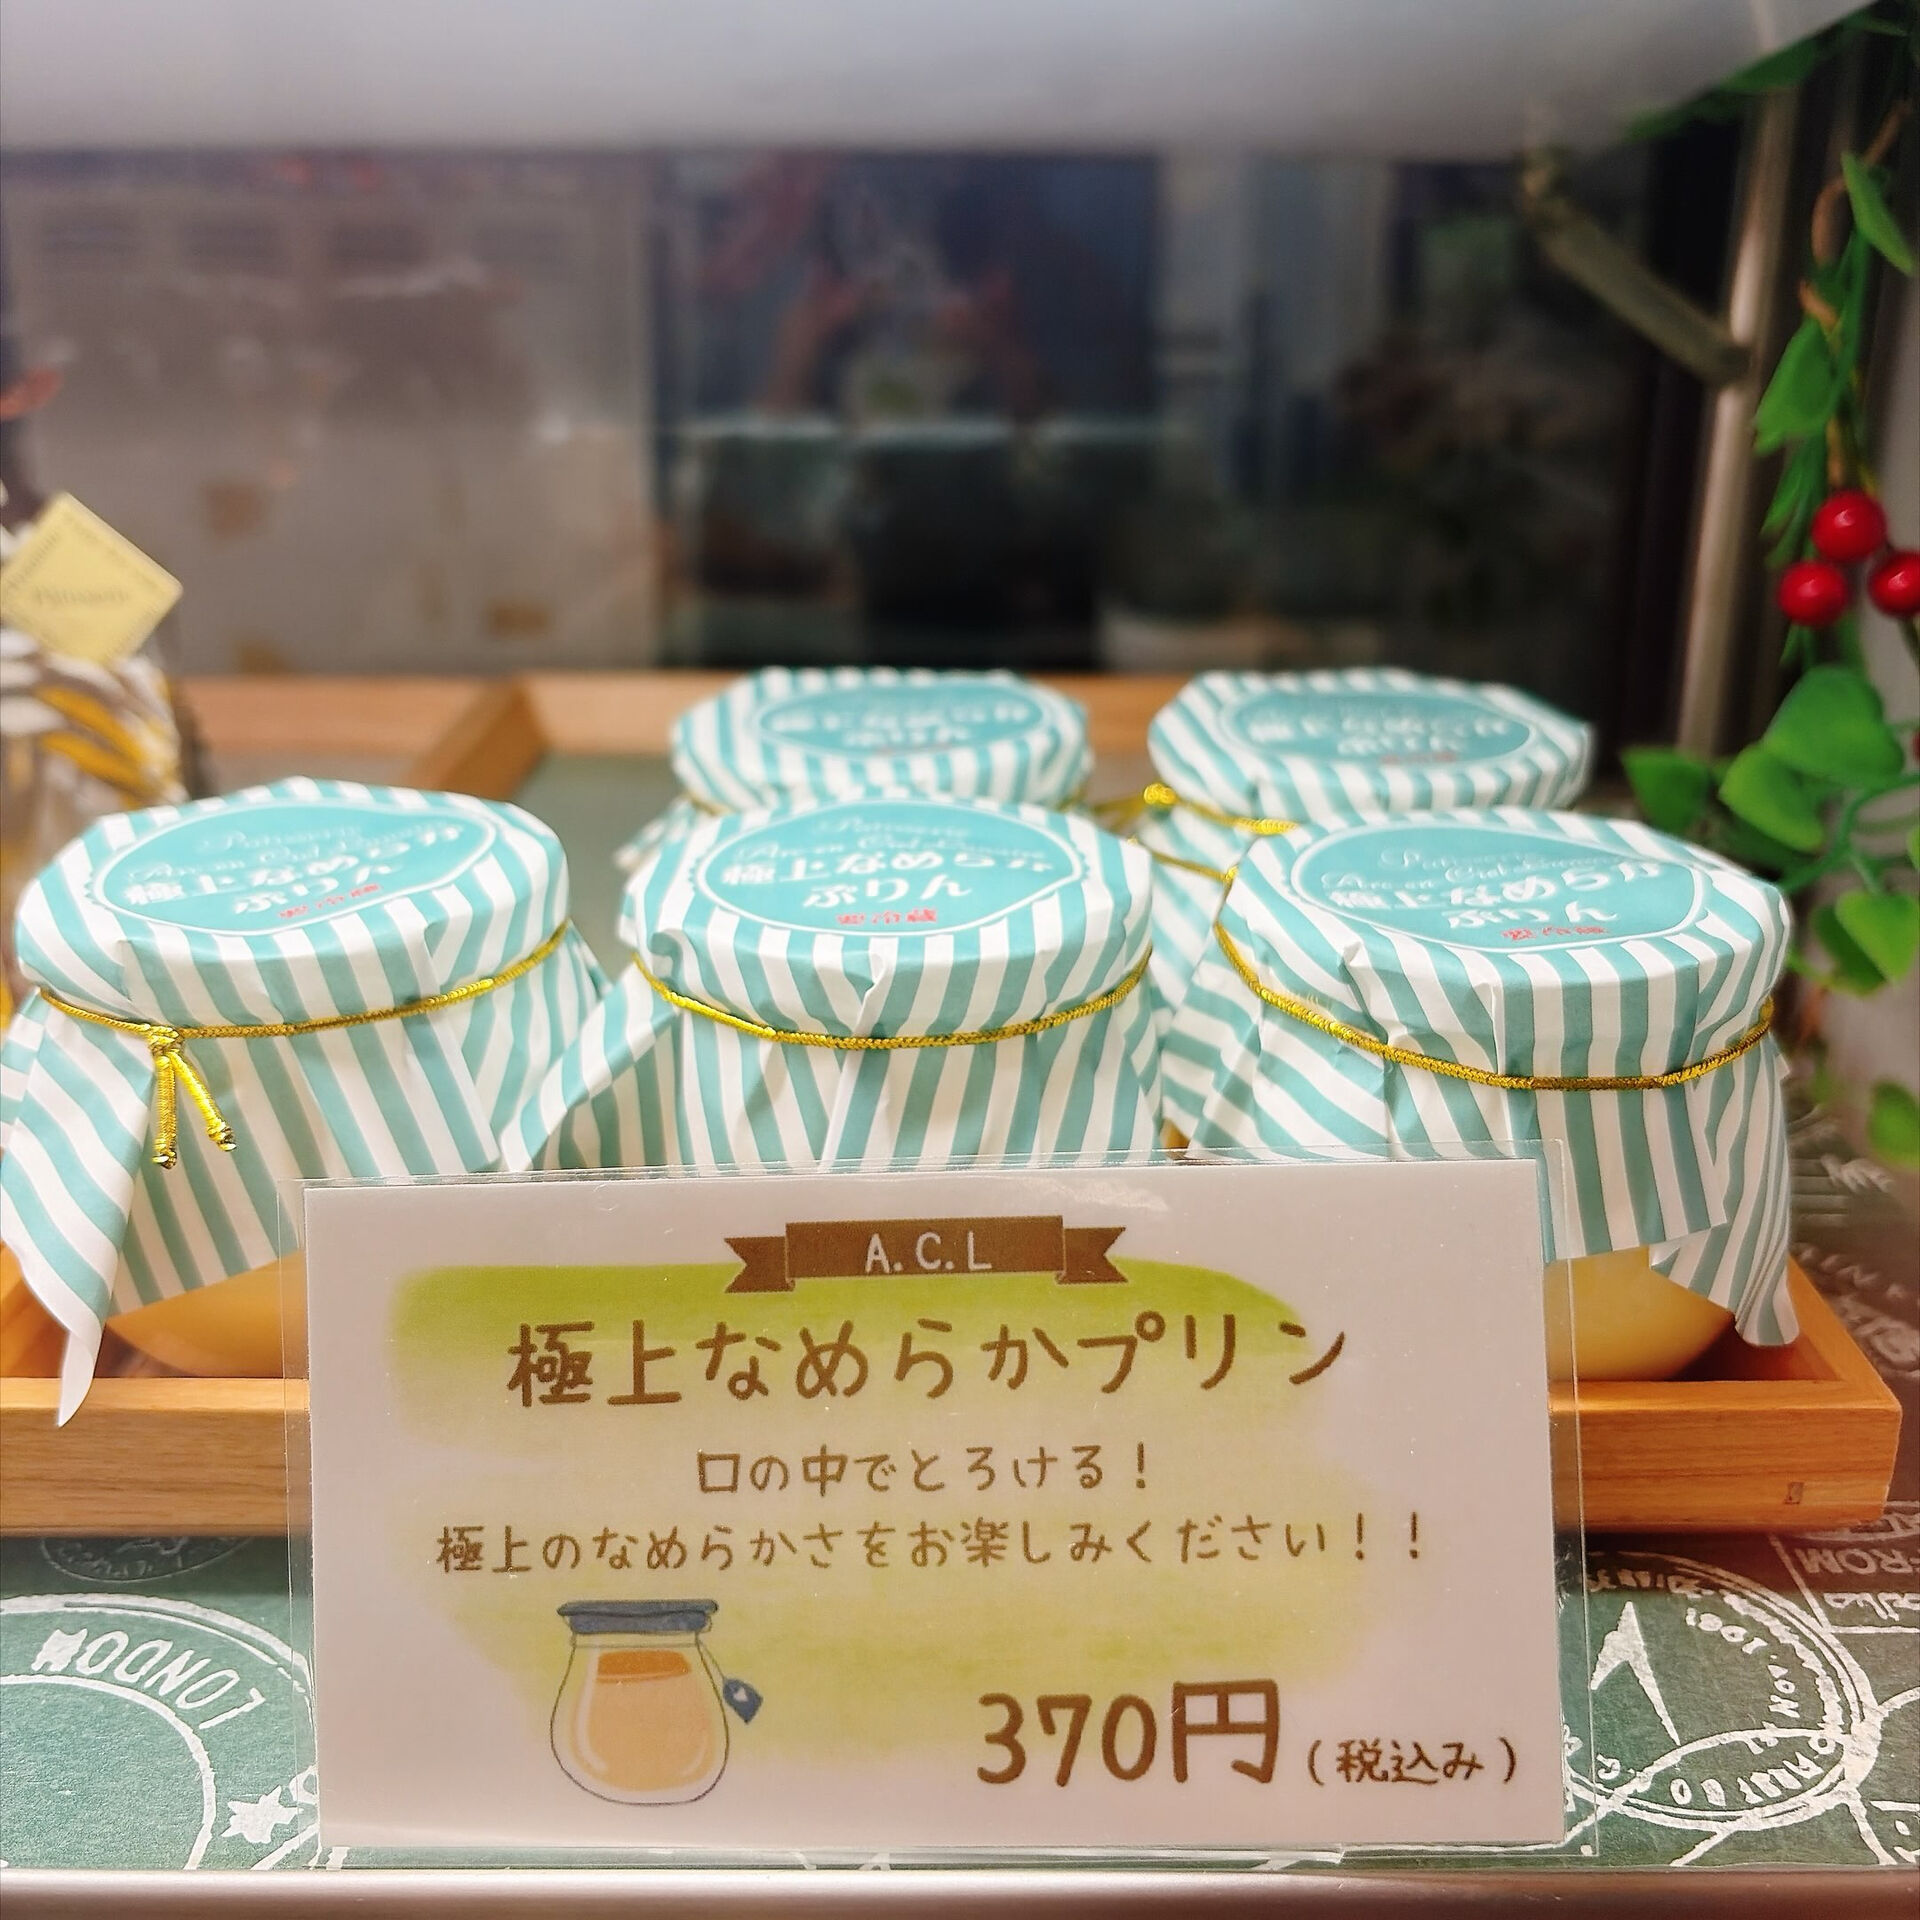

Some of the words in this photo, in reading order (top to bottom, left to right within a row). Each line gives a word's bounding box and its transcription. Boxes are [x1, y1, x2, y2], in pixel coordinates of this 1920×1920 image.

[234, 863, 404, 914] ぷりん
[803, 874, 971, 908] ぷりん
[1442, 901, 1618, 928] ぷりん
[865, 1230, 992, 1274] A.C.L
[507, 1310, 1346, 1407] 極上なめらかプリン
[697, 1442, 1147, 1497] 口の中でとろける！
[436, 1512, 1419, 1575] 極上のなめらかさをお楽しみください！！
[1795, 1547, 1920, 1575] ROM
[976, 1678, 1280, 1788] 370円
[1307, 1736, 1517, 1786] （税込み）
